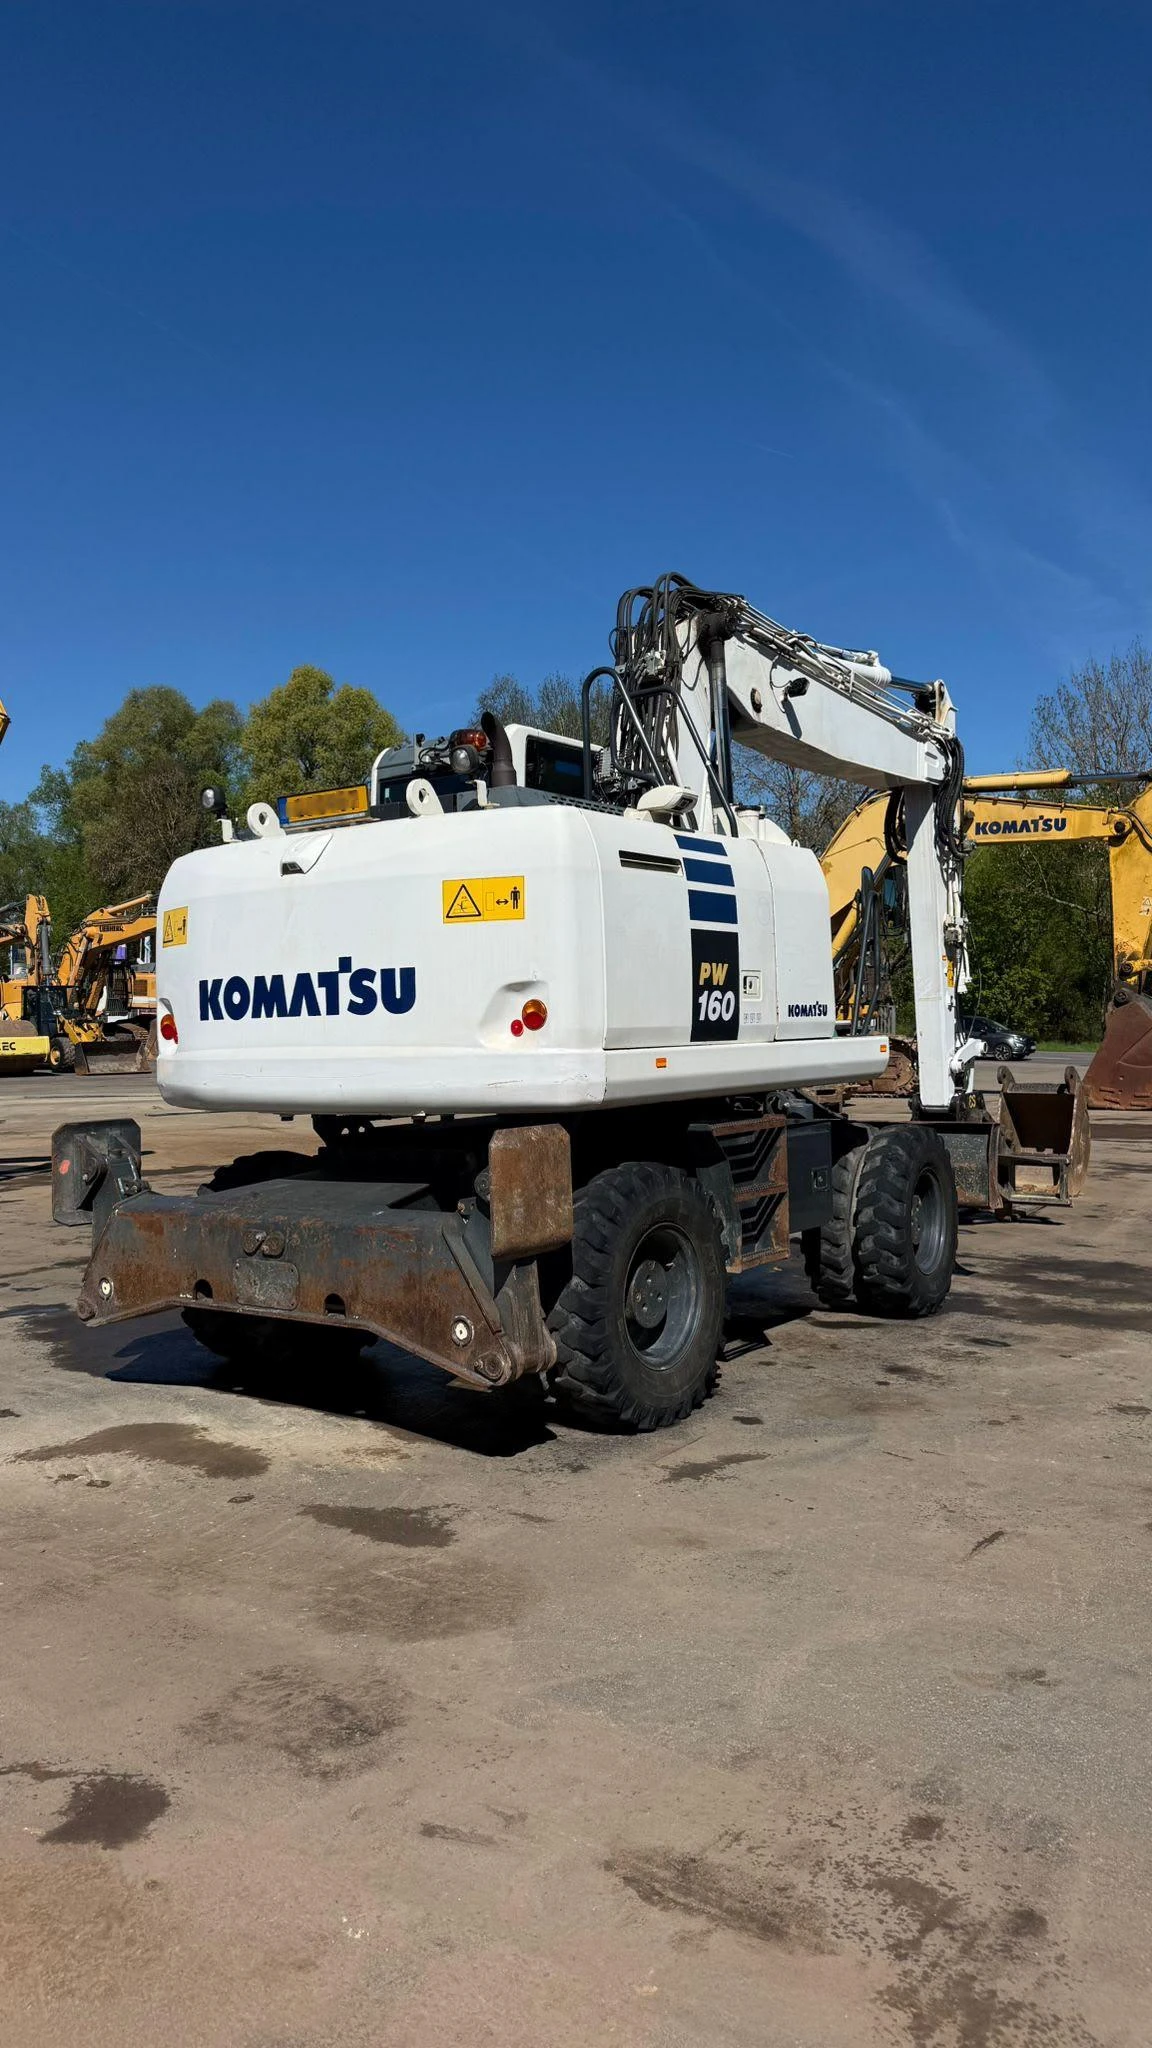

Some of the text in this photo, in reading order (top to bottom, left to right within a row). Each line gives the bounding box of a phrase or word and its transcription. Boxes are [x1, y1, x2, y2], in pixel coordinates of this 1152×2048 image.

[975, 815, 1067, 835] KOMATSU
[698, 962, 729, 986] PW
[199, 956, 416, 1021] KOMATSU
[698, 990, 736, 1022] 160
[787, 1001, 828, 1018] KOMATSU
[0, 1041, 17, 1051] EC
